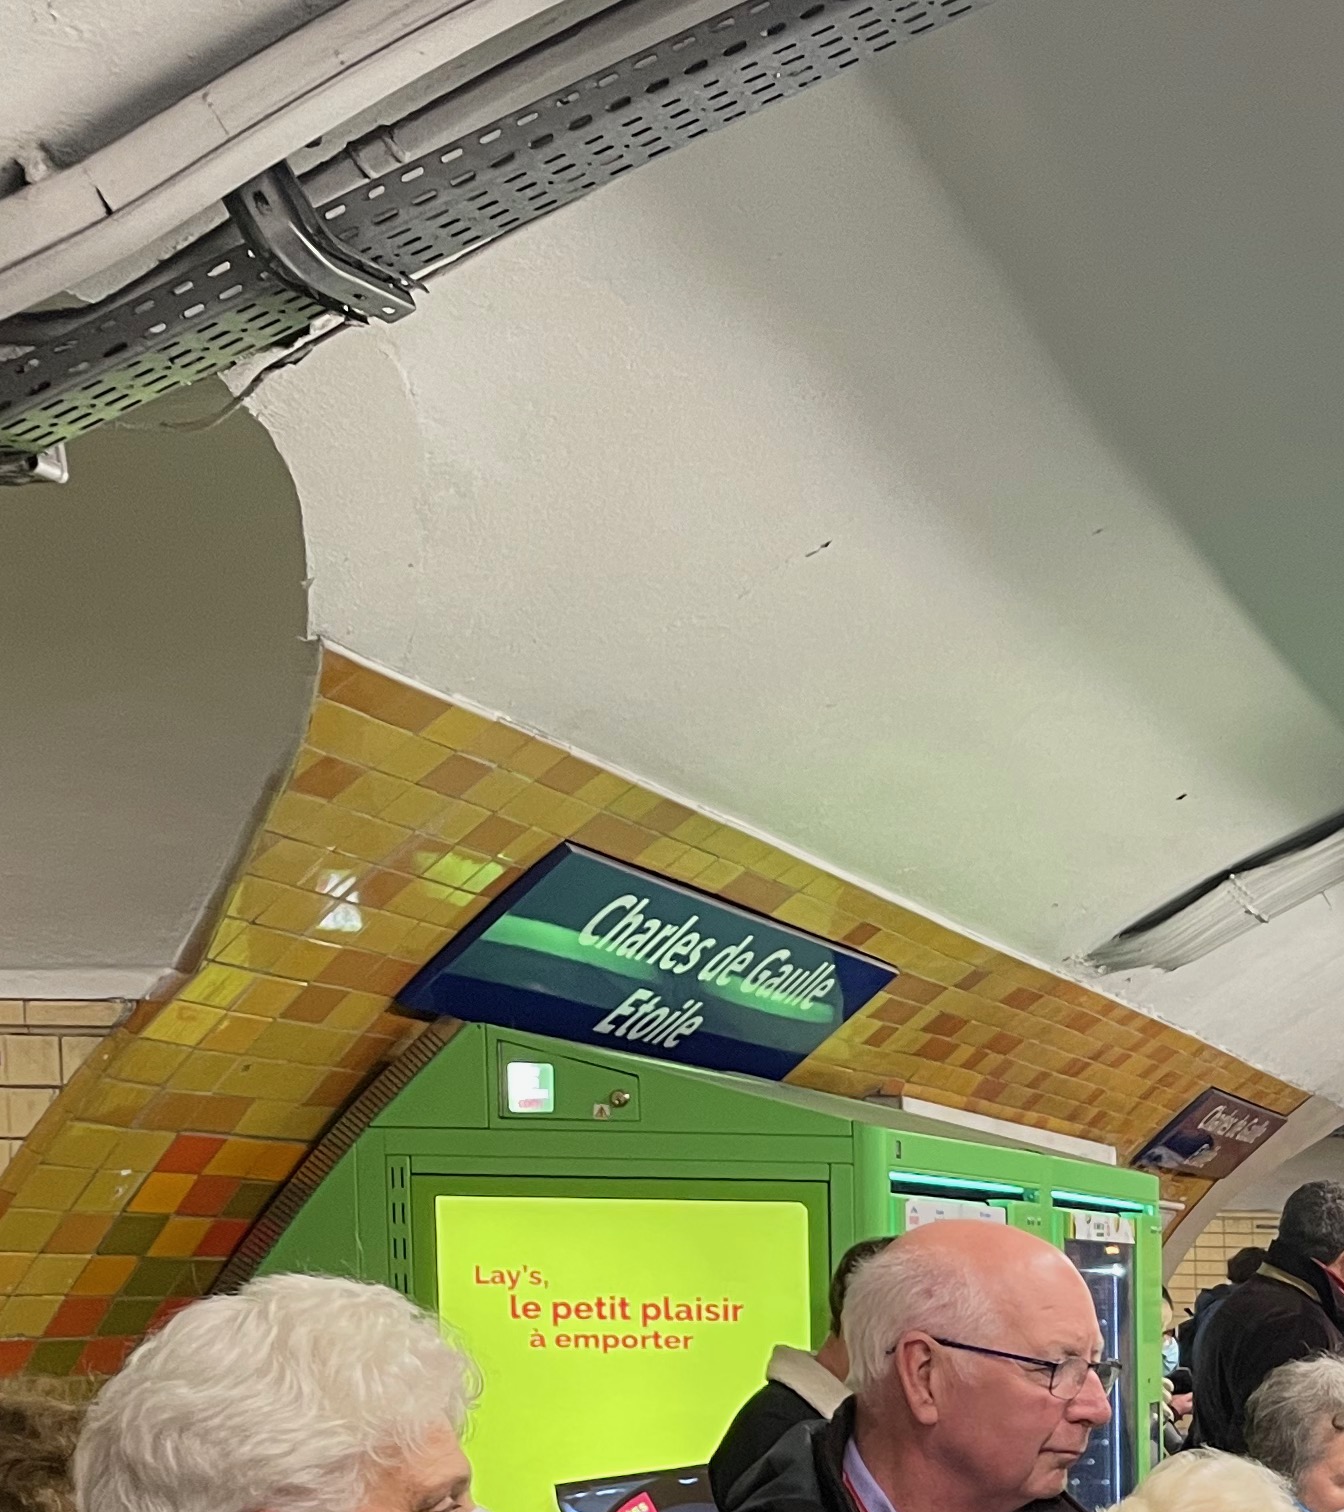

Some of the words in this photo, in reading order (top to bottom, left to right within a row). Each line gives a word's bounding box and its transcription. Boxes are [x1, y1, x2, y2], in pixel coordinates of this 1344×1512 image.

[578, 894, 716, 974] Charles
[697, 935, 754, 986] de
[739, 949, 836, 1010] Gaulle
[592, 988, 704, 1048] Etoile
[475, 1264, 549, 1290] Lay's,
[509, 1294, 541, 1320] le
[552, 1296, 631, 1327] petit
[641, 1296, 744, 1327] plaisir
[529, 1328, 546, 1349] à
[555, 1331, 694, 1354] emporter
